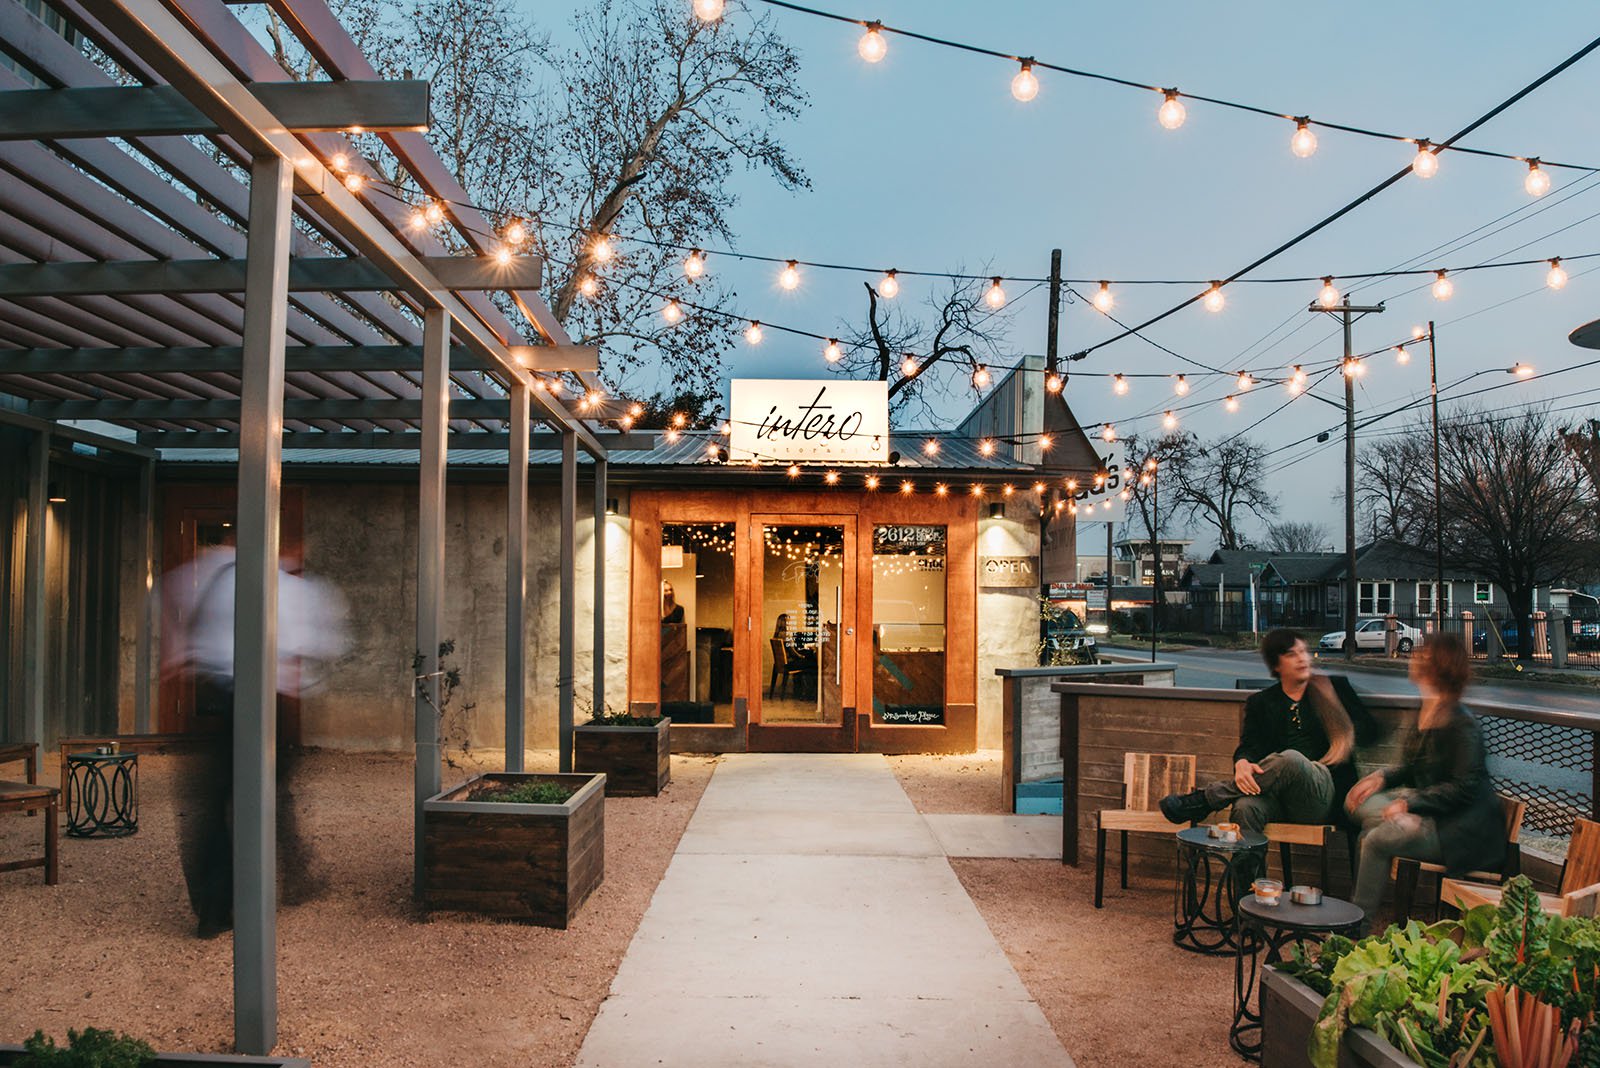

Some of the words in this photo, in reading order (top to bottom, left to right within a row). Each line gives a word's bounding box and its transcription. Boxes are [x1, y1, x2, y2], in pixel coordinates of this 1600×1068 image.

[757, 386, 862, 441] intero
[878, 527, 914, 541] 2612
[986, 560, 1031, 574] OPEN
